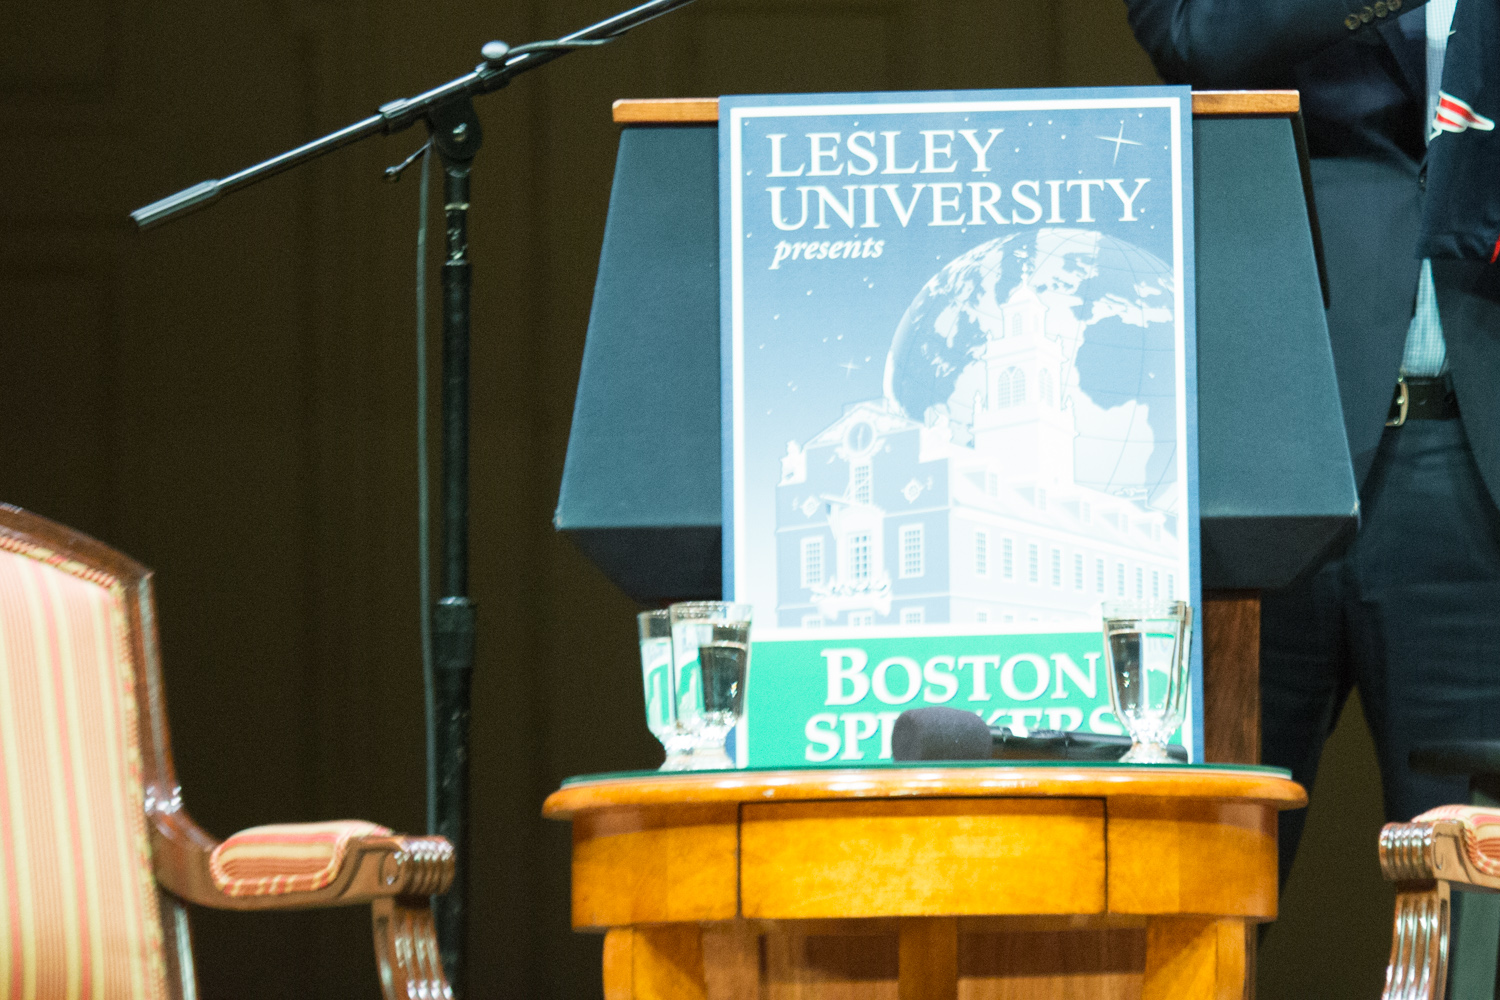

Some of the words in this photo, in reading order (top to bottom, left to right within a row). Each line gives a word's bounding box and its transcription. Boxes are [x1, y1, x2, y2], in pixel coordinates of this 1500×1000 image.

[766, 128, 1004, 177] LESLEY
[765, 177, 1151, 231] UNIVERSITY
[768, 237, 885, 270] presents
[804, 706, 1124, 762] SPERS
